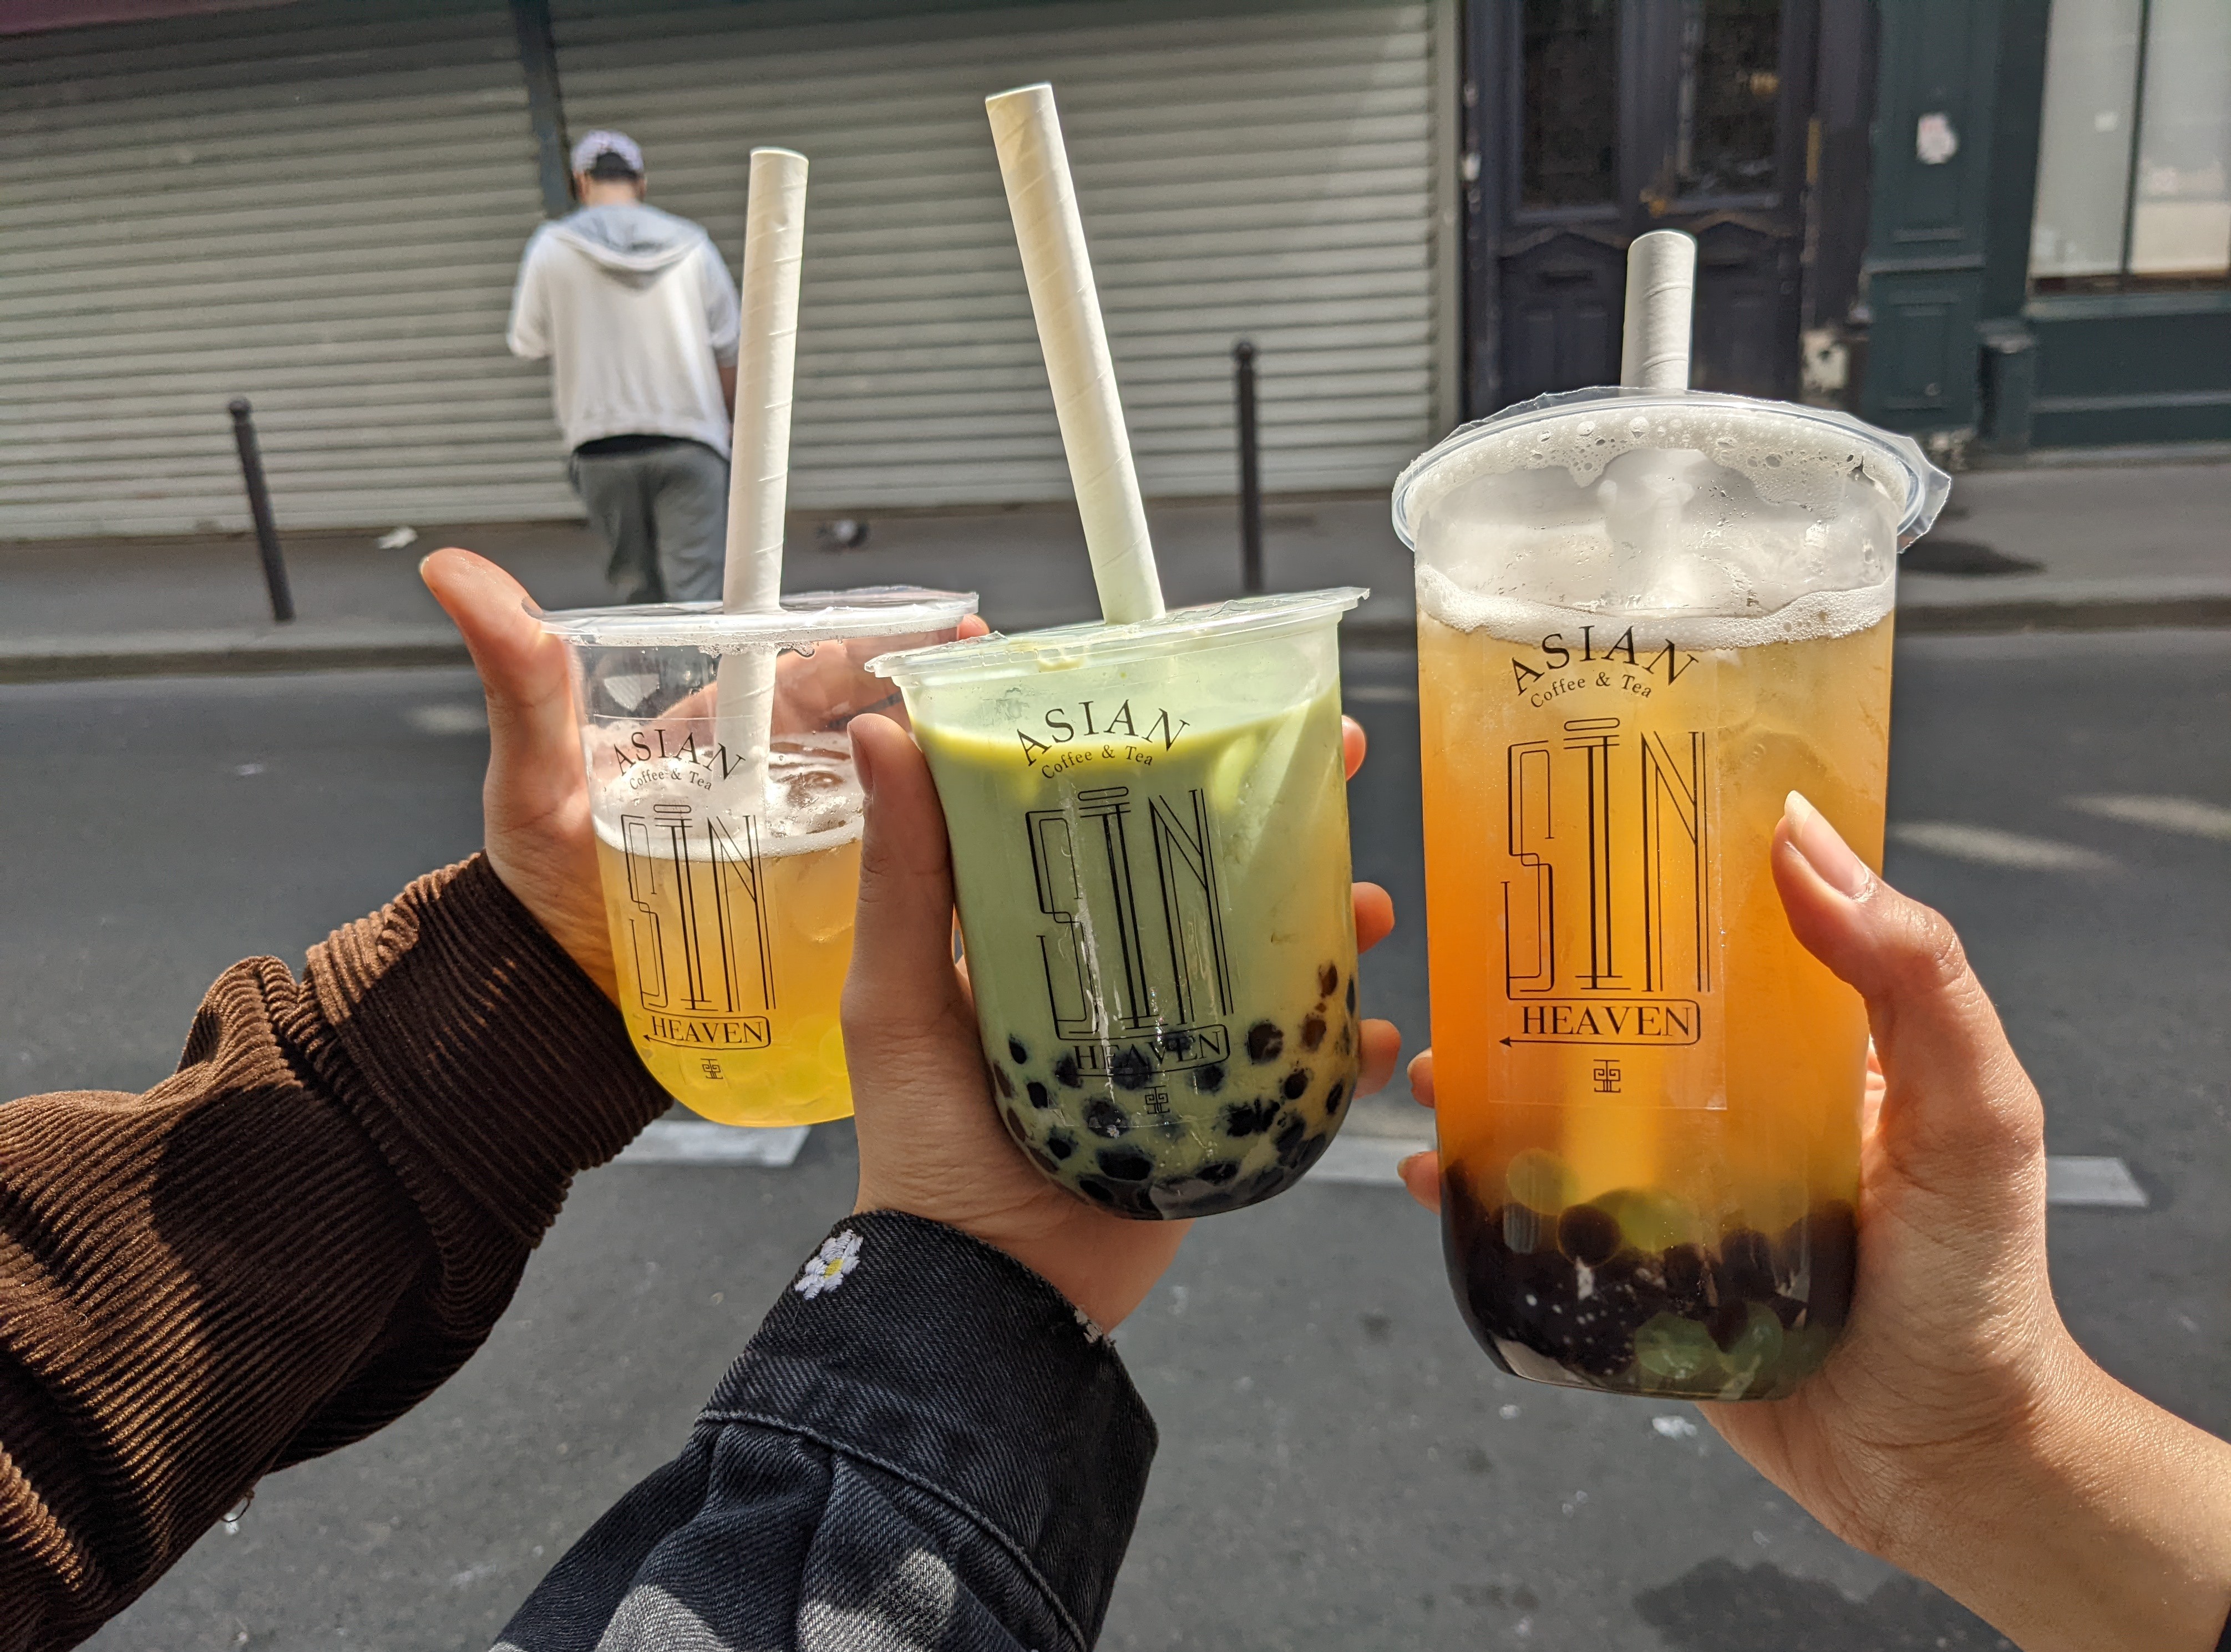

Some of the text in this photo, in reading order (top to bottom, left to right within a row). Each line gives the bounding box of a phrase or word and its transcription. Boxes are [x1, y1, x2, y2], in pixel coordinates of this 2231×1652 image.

[1512, 625, 1698, 695] ASIAN
[1530, 672, 1651, 708] Coffee & Tea
[614, 729, 746, 780] ASIAN
[1017, 699, 1190, 766] ASIAN
[630, 768, 712, 791] Coffee & Tea
[1042, 744, 1153, 779] Coffee & Tea
[1500, 718, 1710, 1000] SIN
[621, 804, 776, 1013] SIN
[1025, 786, 1234, 1040] SIN
[652, 1015, 764, 1044] HEAVEN
[1521, 1005, 1692, 1036] HEAVEN
